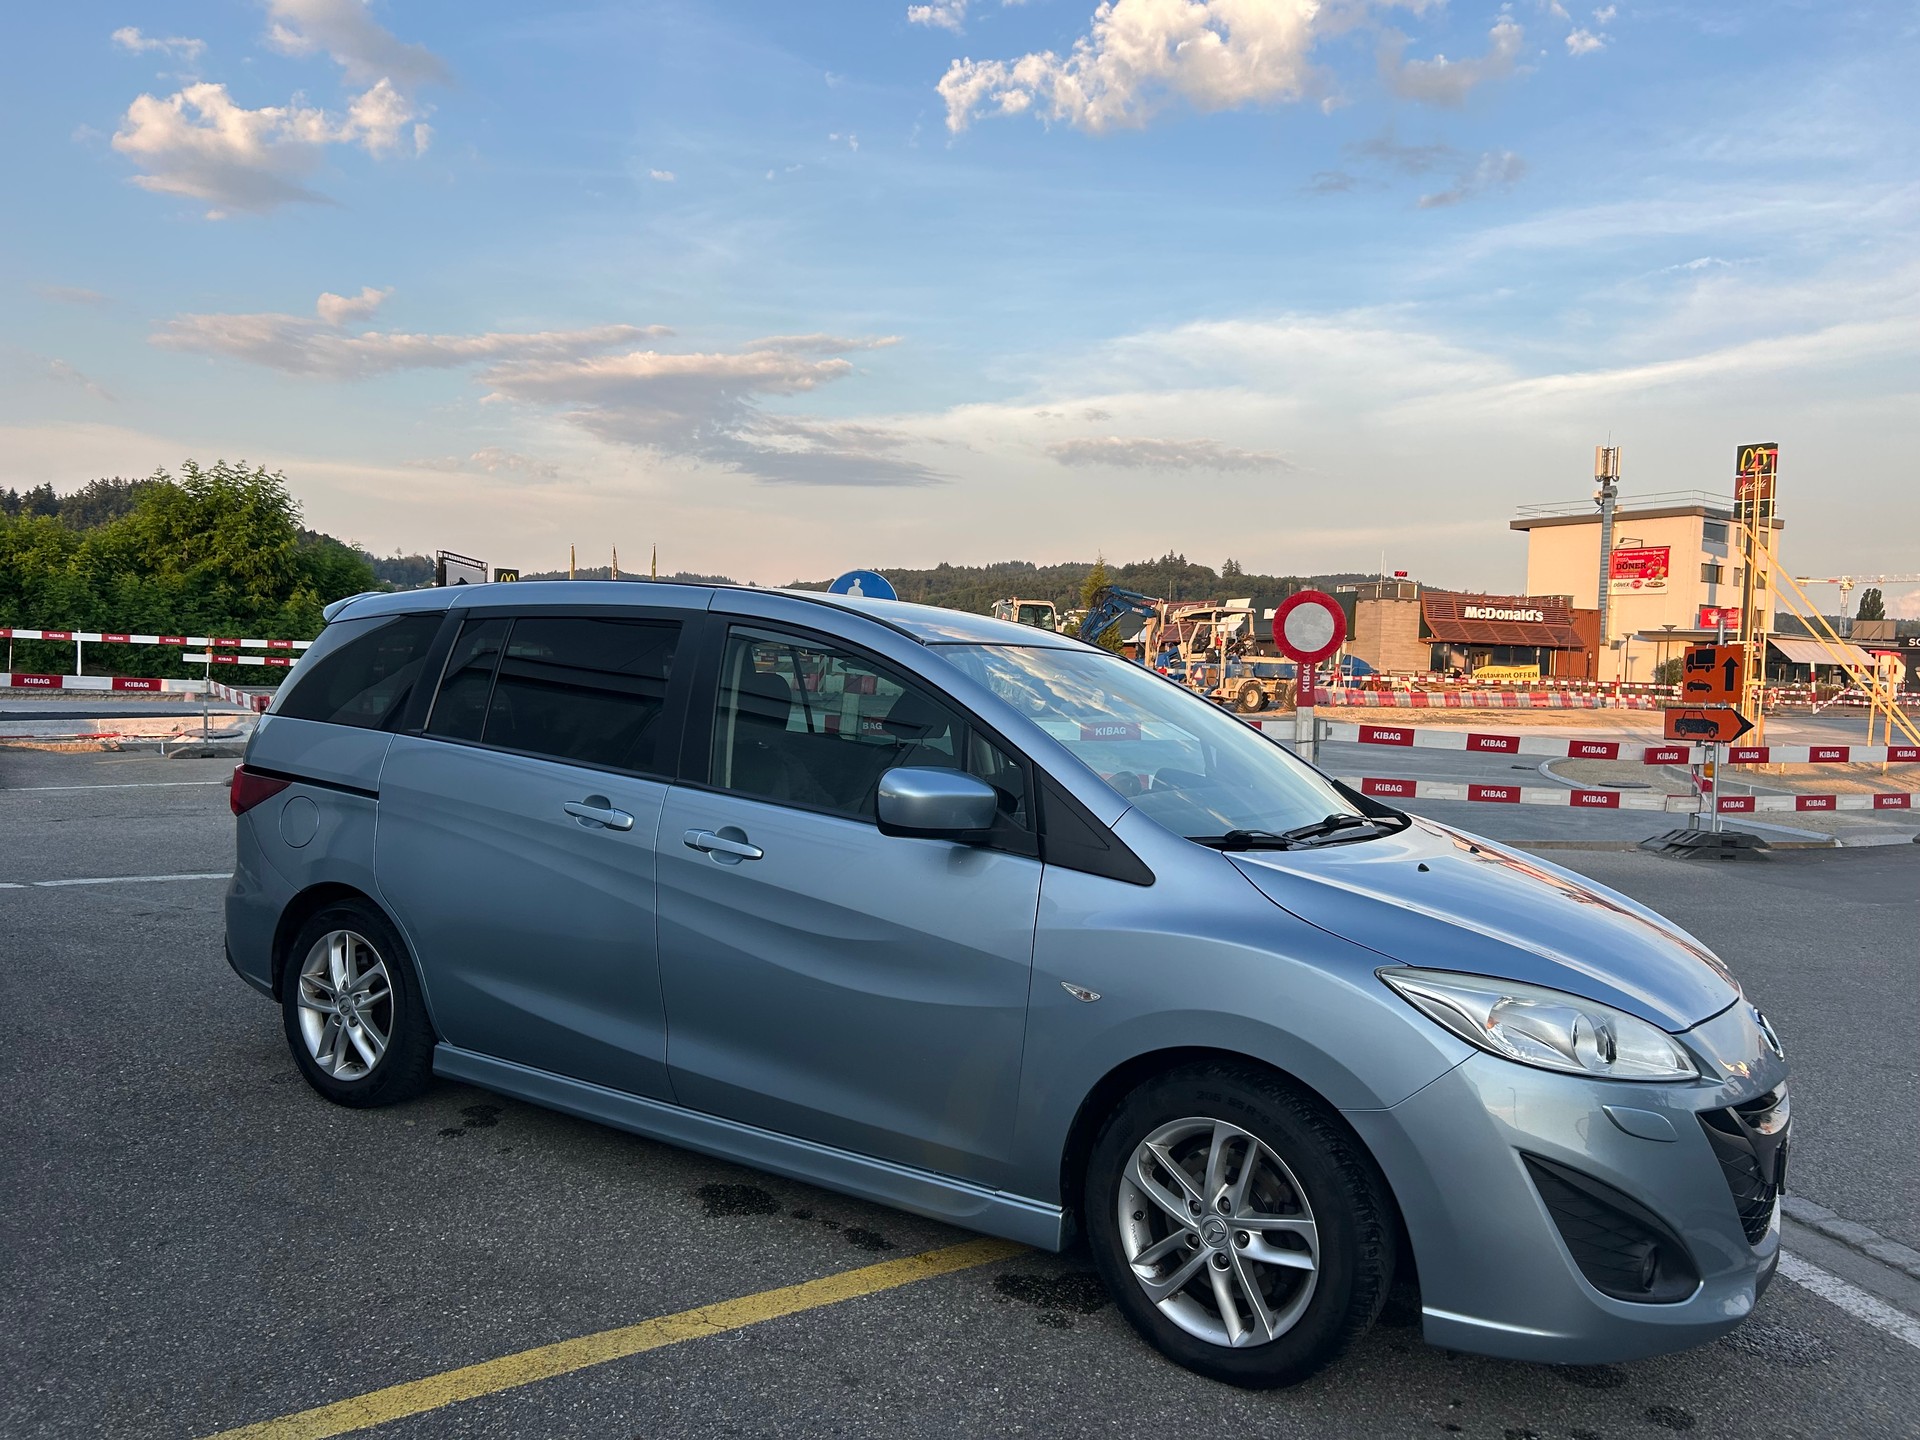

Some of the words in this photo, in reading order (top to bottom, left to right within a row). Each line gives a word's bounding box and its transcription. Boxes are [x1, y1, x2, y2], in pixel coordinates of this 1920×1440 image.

[1464, 606, 1544, 622] McDonald's
[23, 677, 50, 685] KIBAG
[1095, 726, 1127, 736] KIBAG
[1373, 731, 1401, 741] KIBAG
[1480, 738, 1507, 748] KIBAG
[1582, 745, 1607, 754] KIBAG
[1896, 750, 1917, 758] KIBAG
[1656, 752, 1679, 760] KIBAG
[1738, 750, 1760, 759] KIBAG
[1819, 750, 1840, 759] KIBAG
[1375, 783, 1403, 792] KIBAG
[1480, 789, 1507, 798] KIBAG
[1582, 794, 1608, 804] KIBAG
[1805, 799, 1827, 808] KIBAG
[1882, 797, 1902, 805] KIBAG
[1722, 800, 1745, 809] KIBAG
